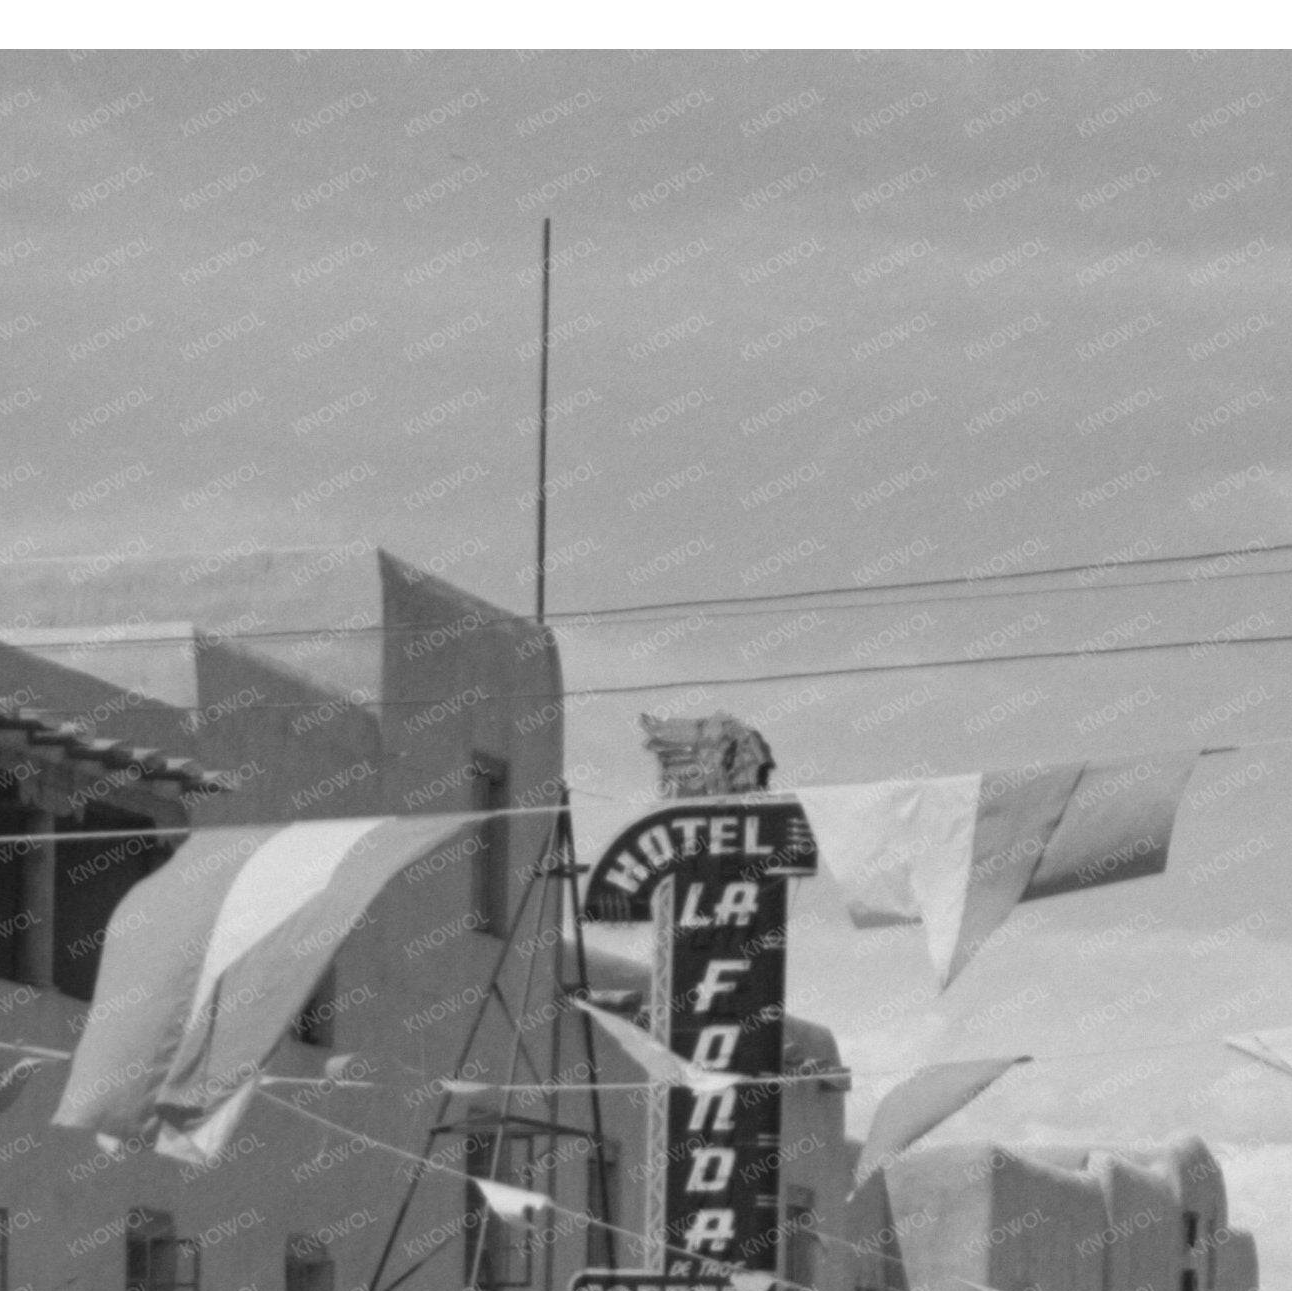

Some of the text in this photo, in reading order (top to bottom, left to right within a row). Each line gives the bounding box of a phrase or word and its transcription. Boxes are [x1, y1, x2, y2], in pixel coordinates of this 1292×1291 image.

[606, 815, 774, 894] HOTEL
[680, 881, 759, 927] LA
[684, 958, 752, 1253] FONDA
[669, 1259, 693, 1278] DE
